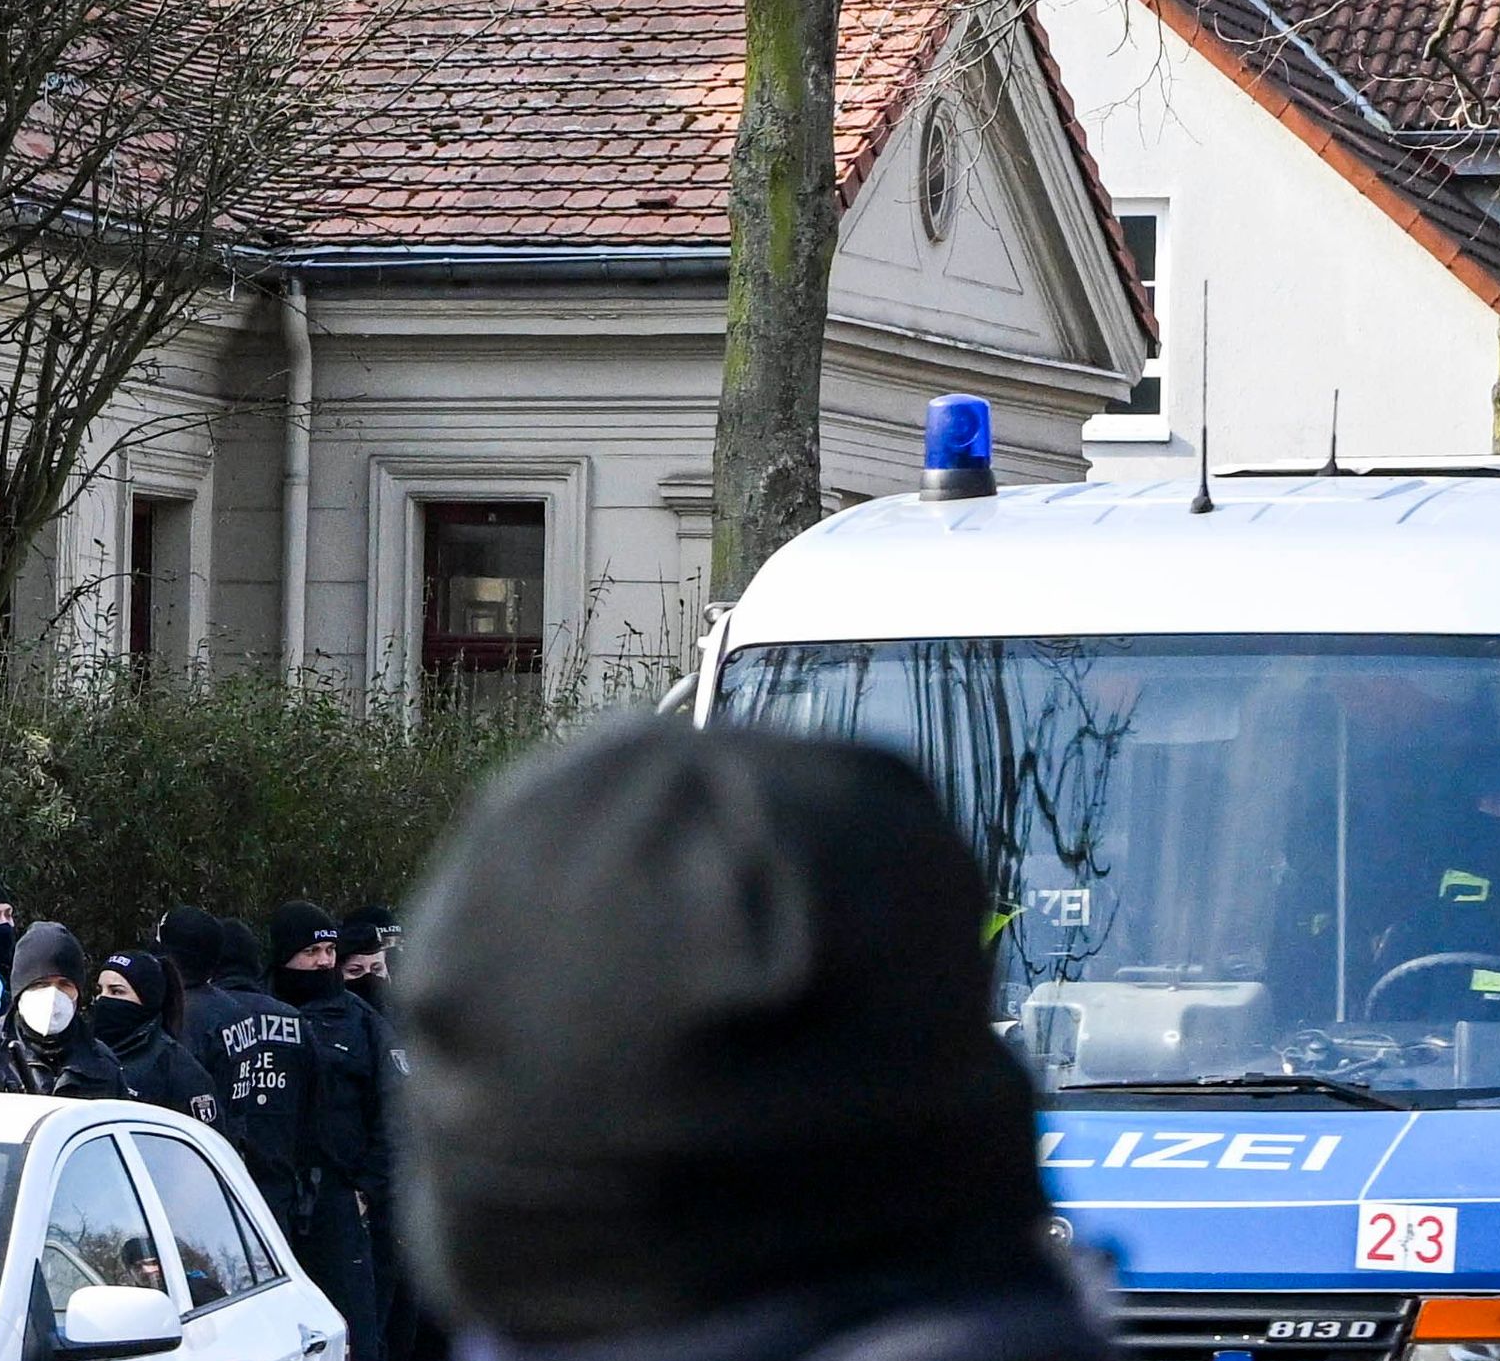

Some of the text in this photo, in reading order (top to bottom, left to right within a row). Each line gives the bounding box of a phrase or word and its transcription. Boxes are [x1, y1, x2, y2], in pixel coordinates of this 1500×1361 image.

[258, 1014, 301, 1045] IZEI
[1036, 1131, 1343, 1171] LIZEI
[1366, 1212, 1445, 1264] 23
[1268, 1320, 1377, 1338] 813 D
